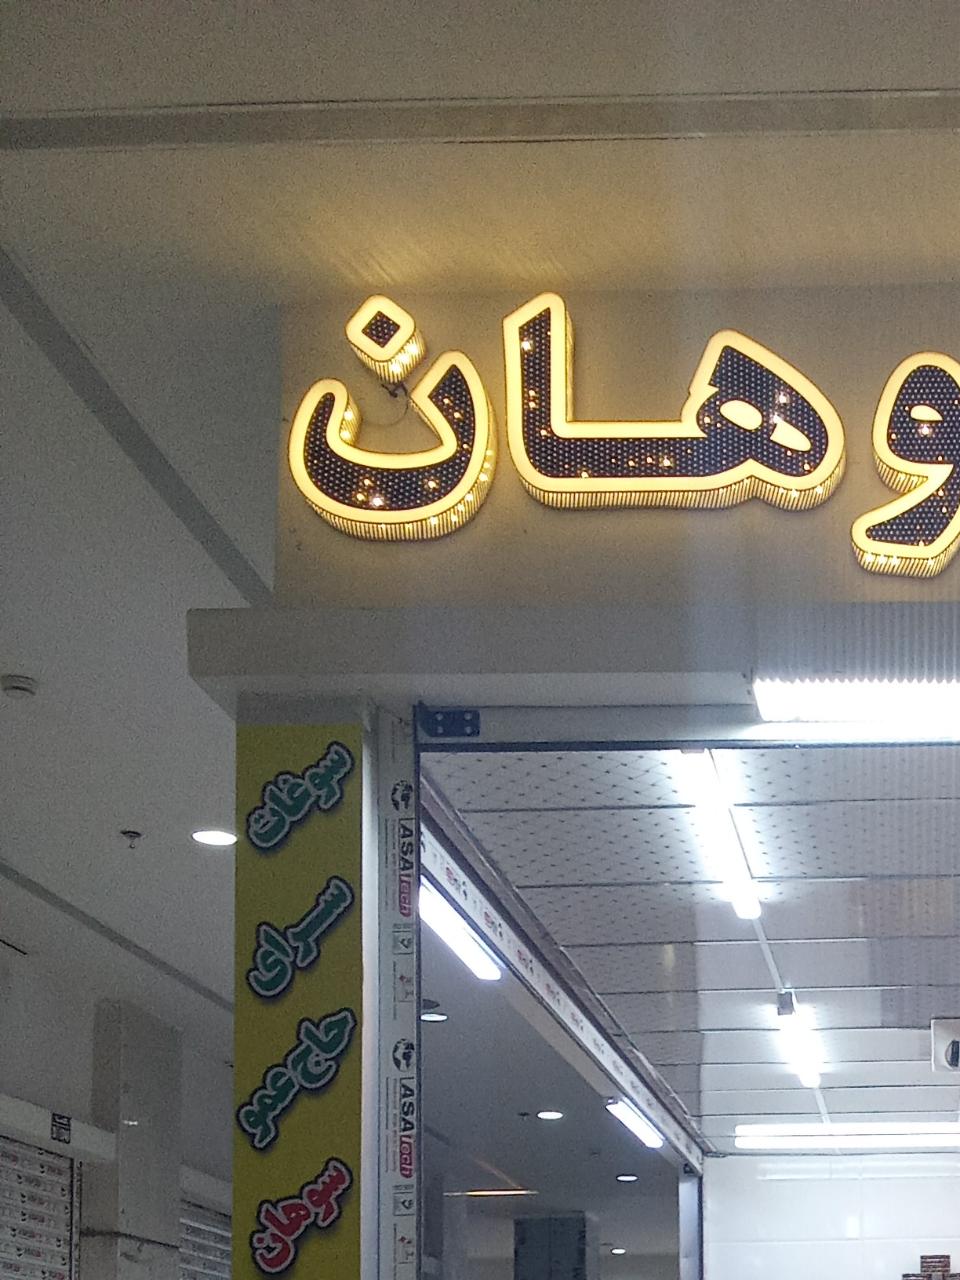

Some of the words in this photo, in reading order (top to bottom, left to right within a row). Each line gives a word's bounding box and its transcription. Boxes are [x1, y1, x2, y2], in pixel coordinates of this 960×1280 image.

[247, 741, 355, 848] سوغات
[247, 875, 355, 998] سرای
[286, 1007, 357, 1090] حاج
[237, 1065, 300, 1149] عمو
[399, 1084, 415, 1179] ASATech
[249, 1157, 354, 1274] سوهان
